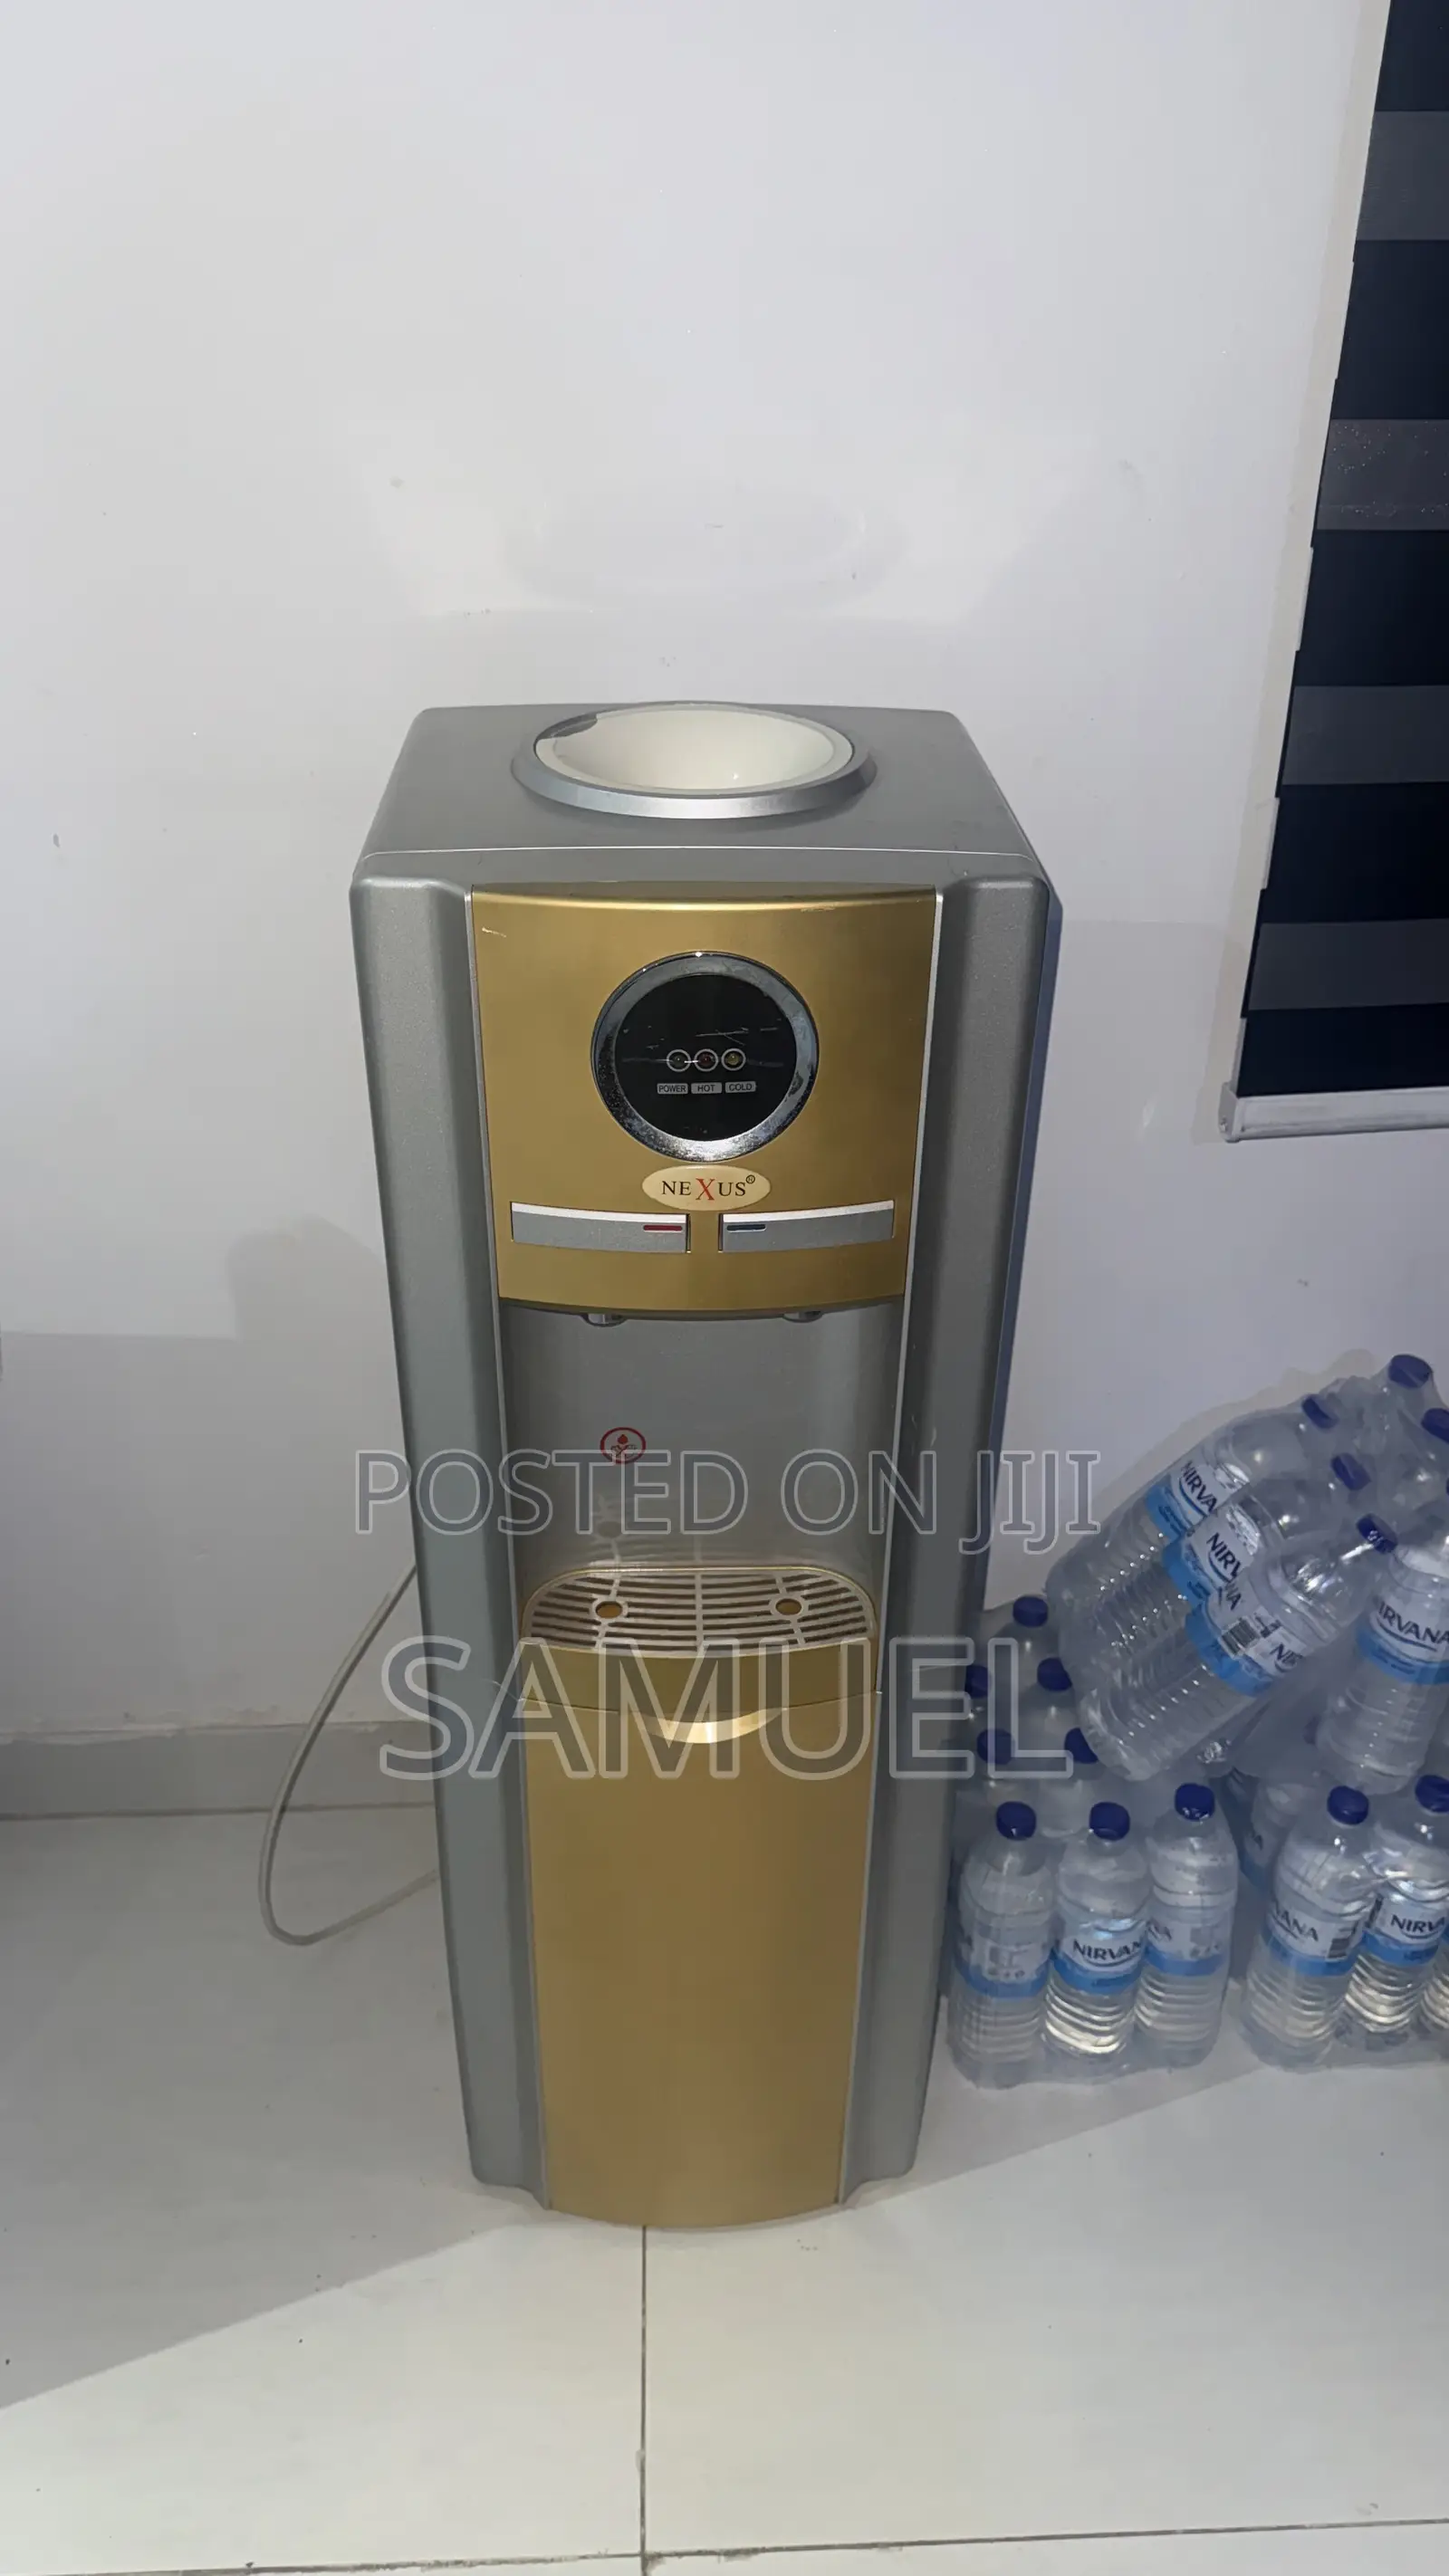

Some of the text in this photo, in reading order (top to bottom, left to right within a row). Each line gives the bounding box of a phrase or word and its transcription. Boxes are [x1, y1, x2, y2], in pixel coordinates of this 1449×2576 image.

[658, 1082, 753, 1093] POWER HOT COLD
